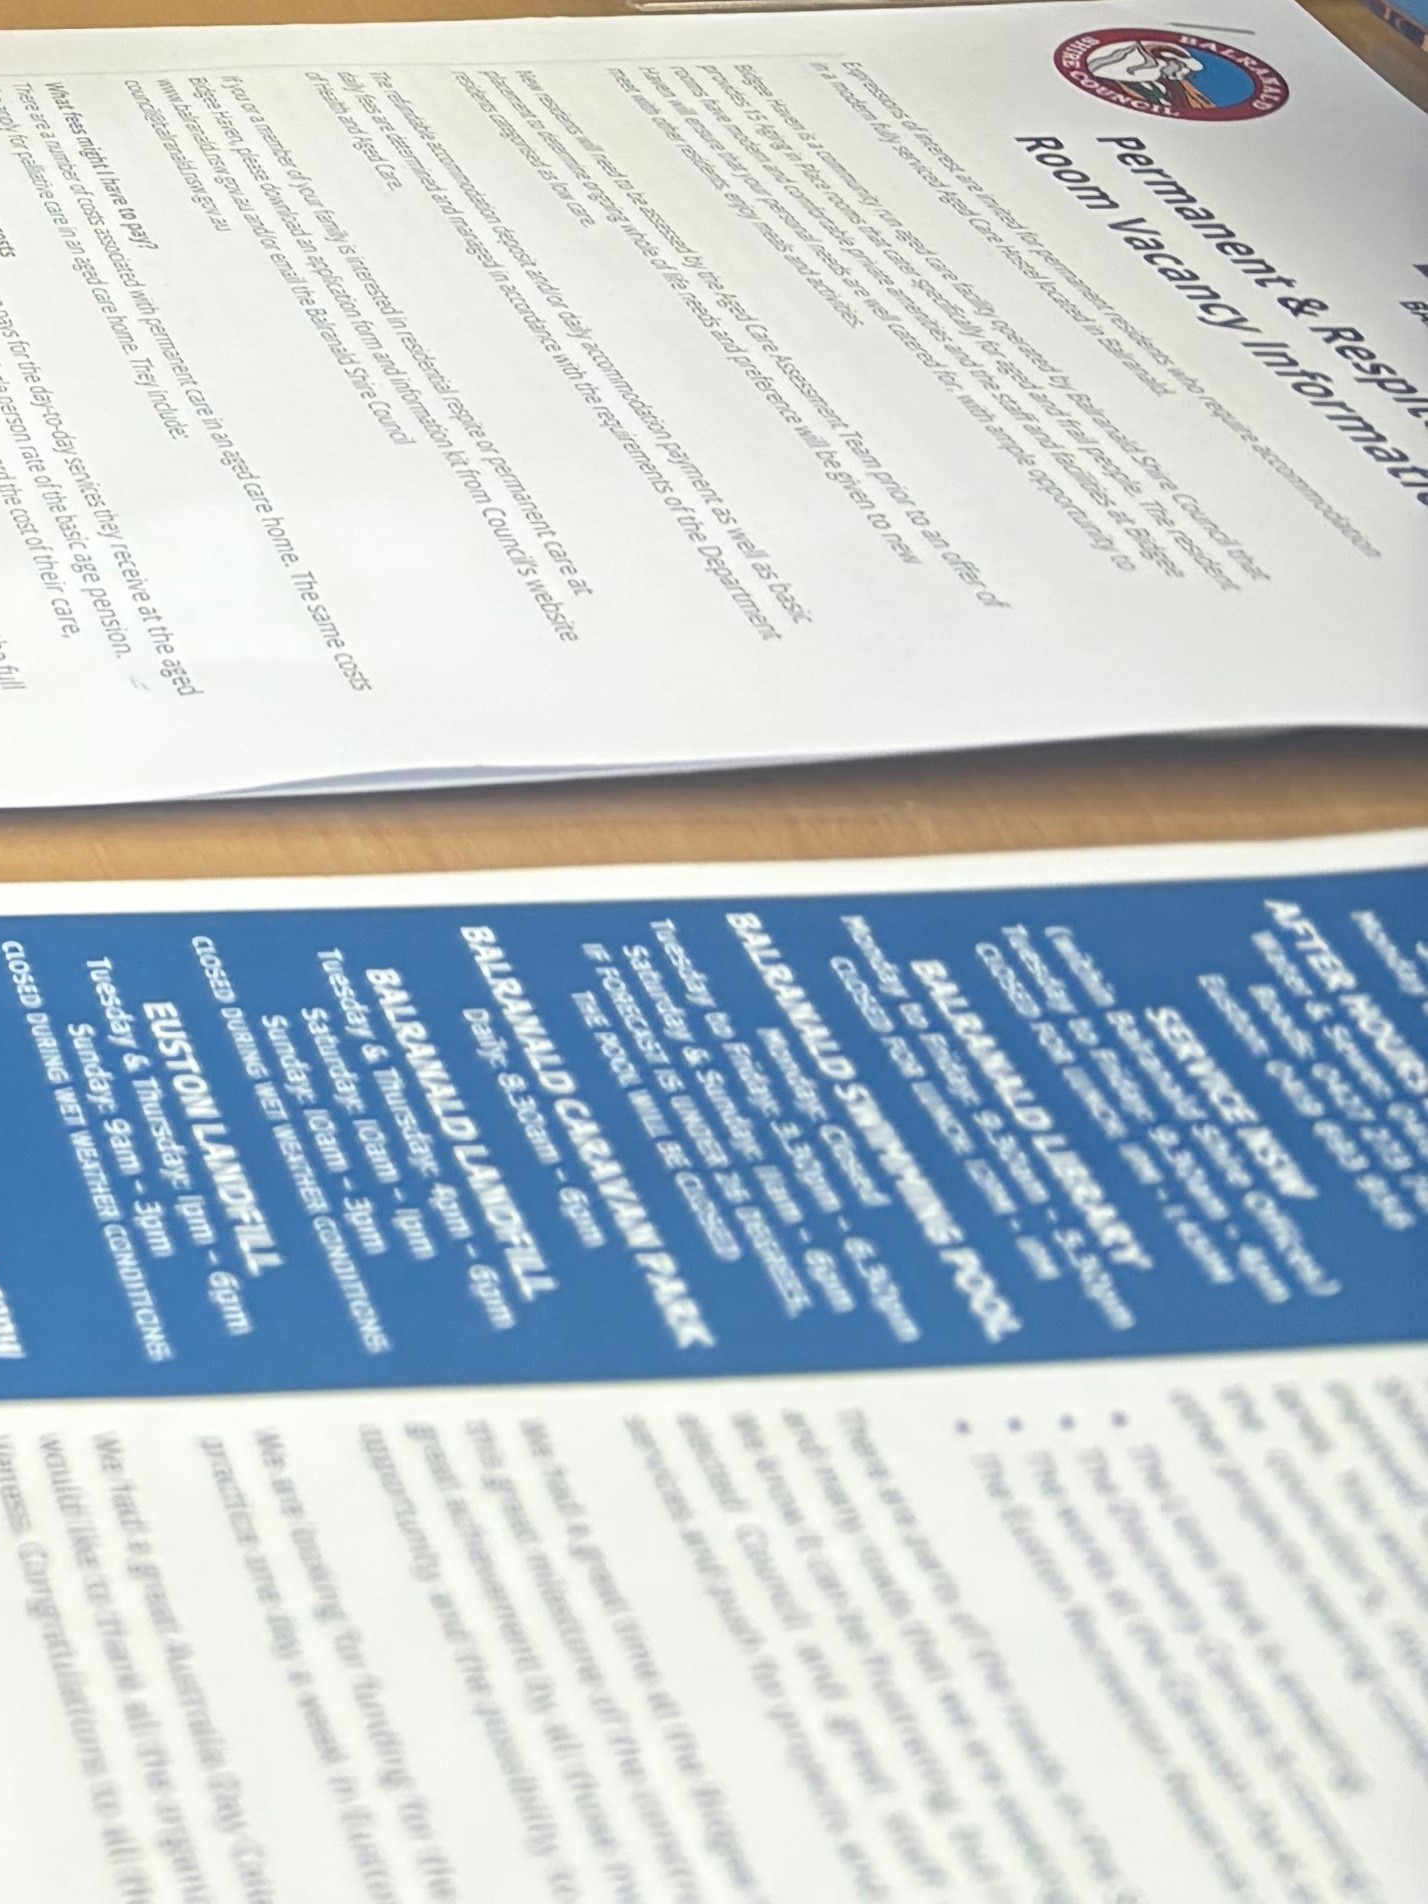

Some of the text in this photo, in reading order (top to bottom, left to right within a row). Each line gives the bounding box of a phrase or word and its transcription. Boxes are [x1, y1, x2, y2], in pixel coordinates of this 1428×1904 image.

[44, 81, 74, 110] What
[1061, 35, 1180, 117] SHIRE COUNCIL
[1179, 35, 1283, 111] BALRANALD
[62, 111, 87, 134] fees
[76, 136, 109, 168] might
[99, 177, 127, 205] have
[117, 207, 137, 220] to
[119, 222, 158, 249] pay?
[1014, 136, 1428, 506] Room Vacancy Informati
[1096, 136, 1428, 428] Permanent & Respi
[9, 508, 39, 535] cost
[24, 536, 53, 551] of
[32, 554, 66, 592] their
[50, 597, 80, 638] care,
[86, 956, 137, 1048] Tuesday
[317, 947, 374, 1039] Tuesday
[122, 1052, 150, 1072] &
[361, 1043, 388, 1063] &
[67, 1023, 116, 1113] Sunday:
[103, 1118, 141, 1174] 9am
[133, 1200, 173, 1256] 3pm
[131, 1076, 190, 1189] Thursday:
[142, 1001, 282, 1276] EUSTON LANDFILL
[191, 935, 389, 1352] CLOSED DURING WET WEATHER CONDITIONS
[261, 1014, 315, 1103] Sunday:
[343, 1196, 386, 1254] 3pm
[365, 968, 555, 1300] BALRANALD LANDFILL
[372, 1066, 439, 1177] Thursday:
[459, 925, 713, 1347] BALRANALD CARAVAN PARK
[725, 912, 1020, 1341] BALRANALD SWIMMING POOL
[910, 959, 1151, 1268] BALRANALD LIBRARY
[1144, 1007, 1317, 1198] SERVICE NSW
[1, 940, 171, 1361] CLOSED DURING WET WEATHER CONDITIONS
[428, 1182, 472, 1238] 4pm
[208, 1271, 251, 1334] 6pm
[468, 1264, 514, 1328] 6pm
